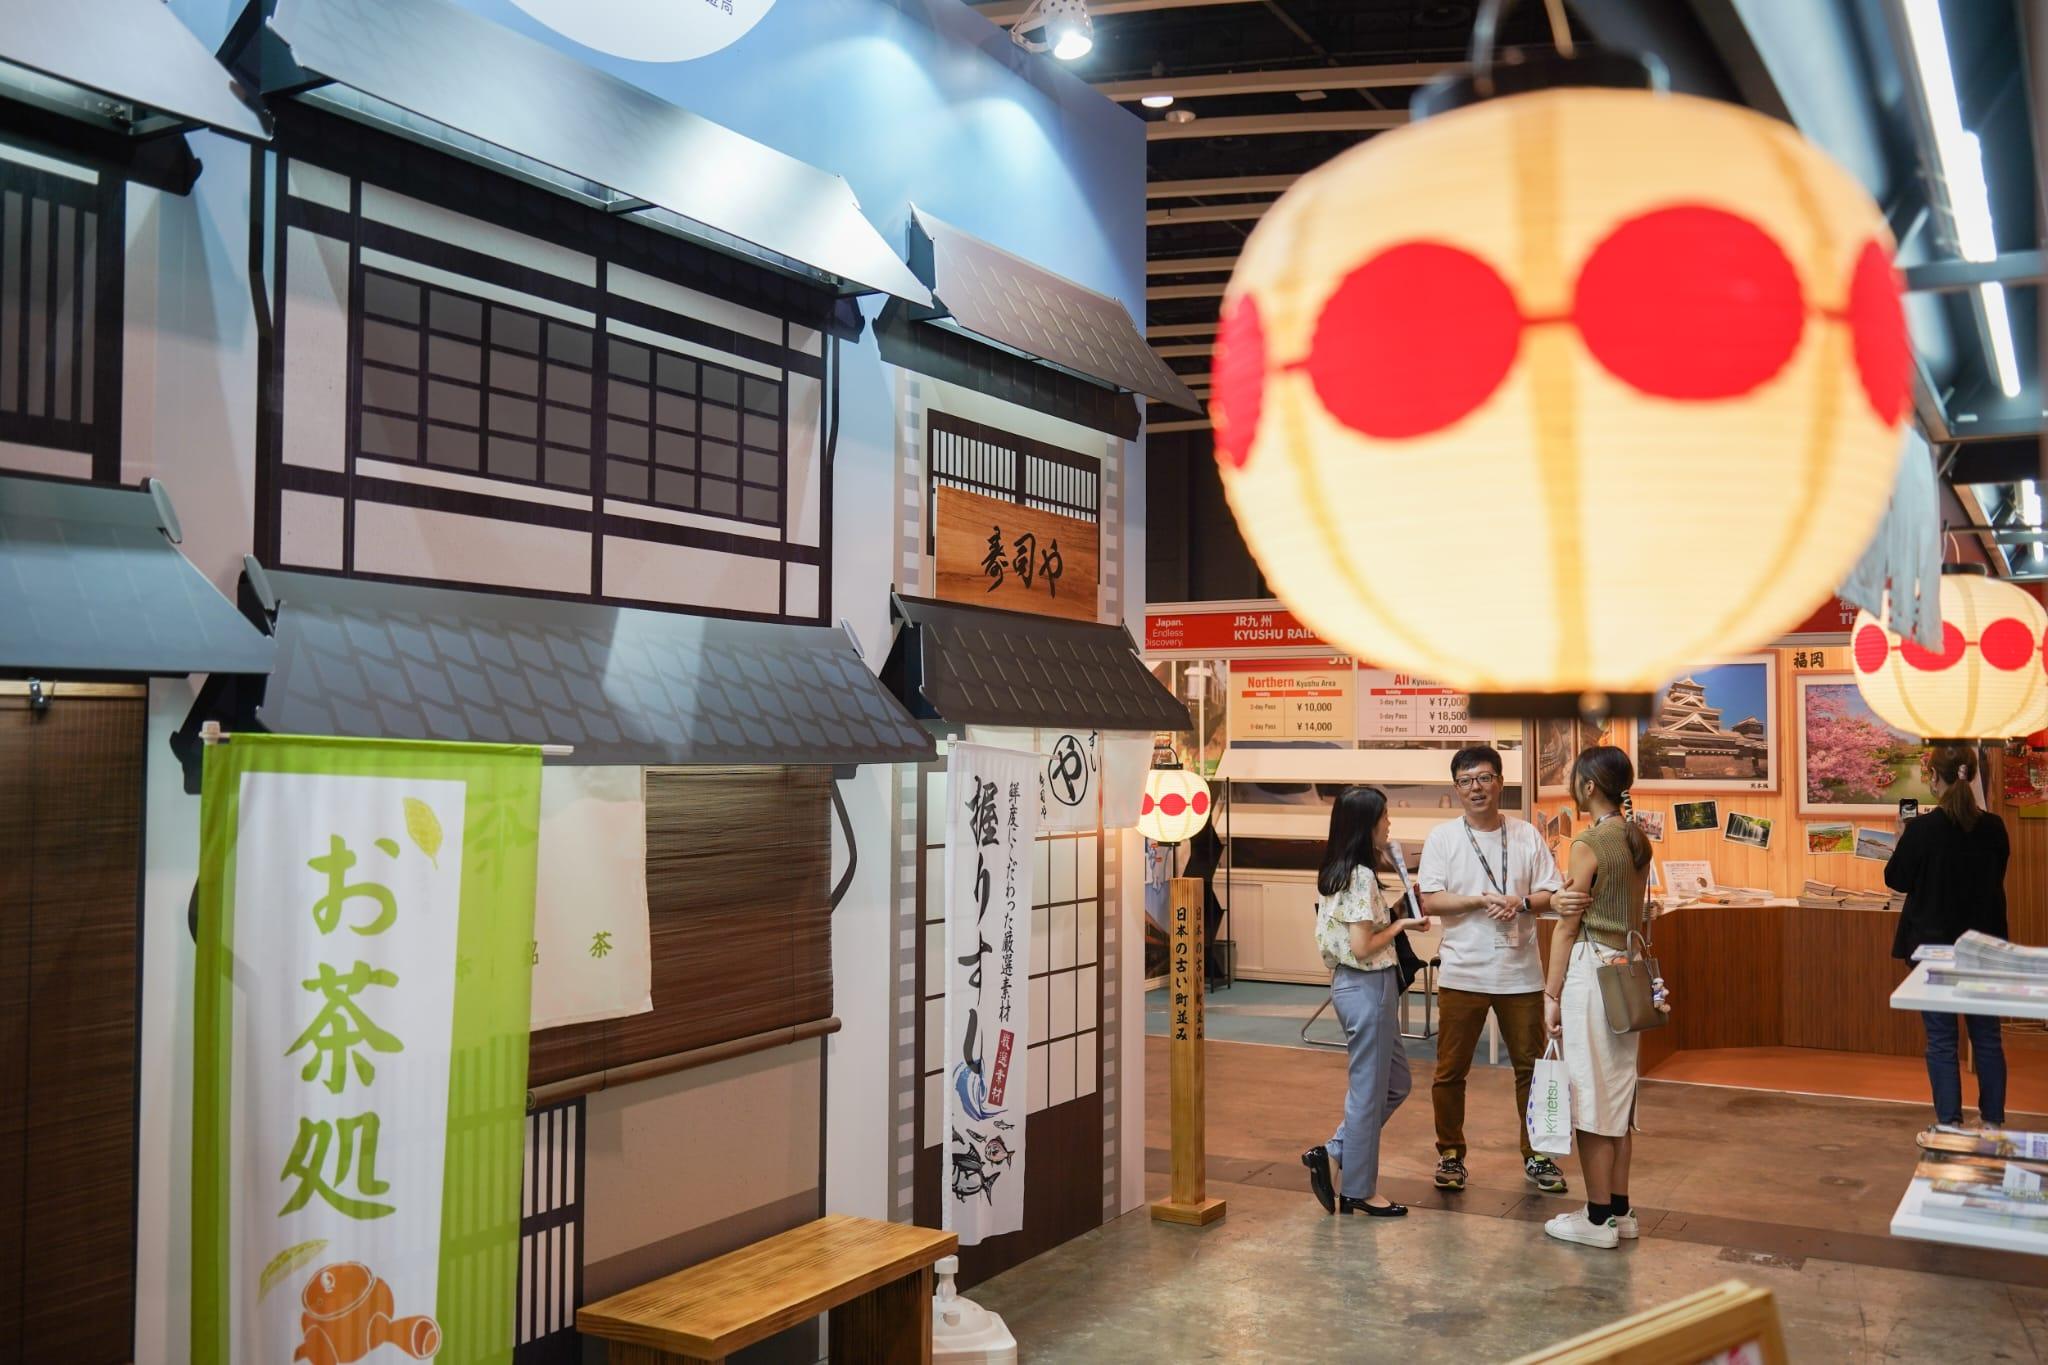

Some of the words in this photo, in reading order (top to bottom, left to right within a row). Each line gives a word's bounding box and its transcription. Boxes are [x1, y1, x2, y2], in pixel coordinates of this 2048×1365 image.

[1155, 618, 1184, 629] Japan.
[1152, 629, 1184, 638] Endless
[1234, 629, 1284, 641] KYUSHU
[1793, 651, 1825, 669] 福岡
[1247, 676, 1295, 688] Northern
[1297, 680, 1320, 688] Kyushu
[1321, 679, 1337, 687] Area
[1394, 674, 1410, 685] All
[1305, 702, 1332, 712] 10,000
[1438, 711, 1467, 721] 18,500
[1305, 722, 1332, 732] 14,000
[1437, 724, 1468, 735] 20,000
[1052, 737, 1082, 802] や
[588, 931, 613, 958] 茶
[1176, 907, 1188, 1041] 日本の古い町並み
[278, 833, 405, 1221] お茶処
[1544, 1080, 1559, 1134] Kintetsu
